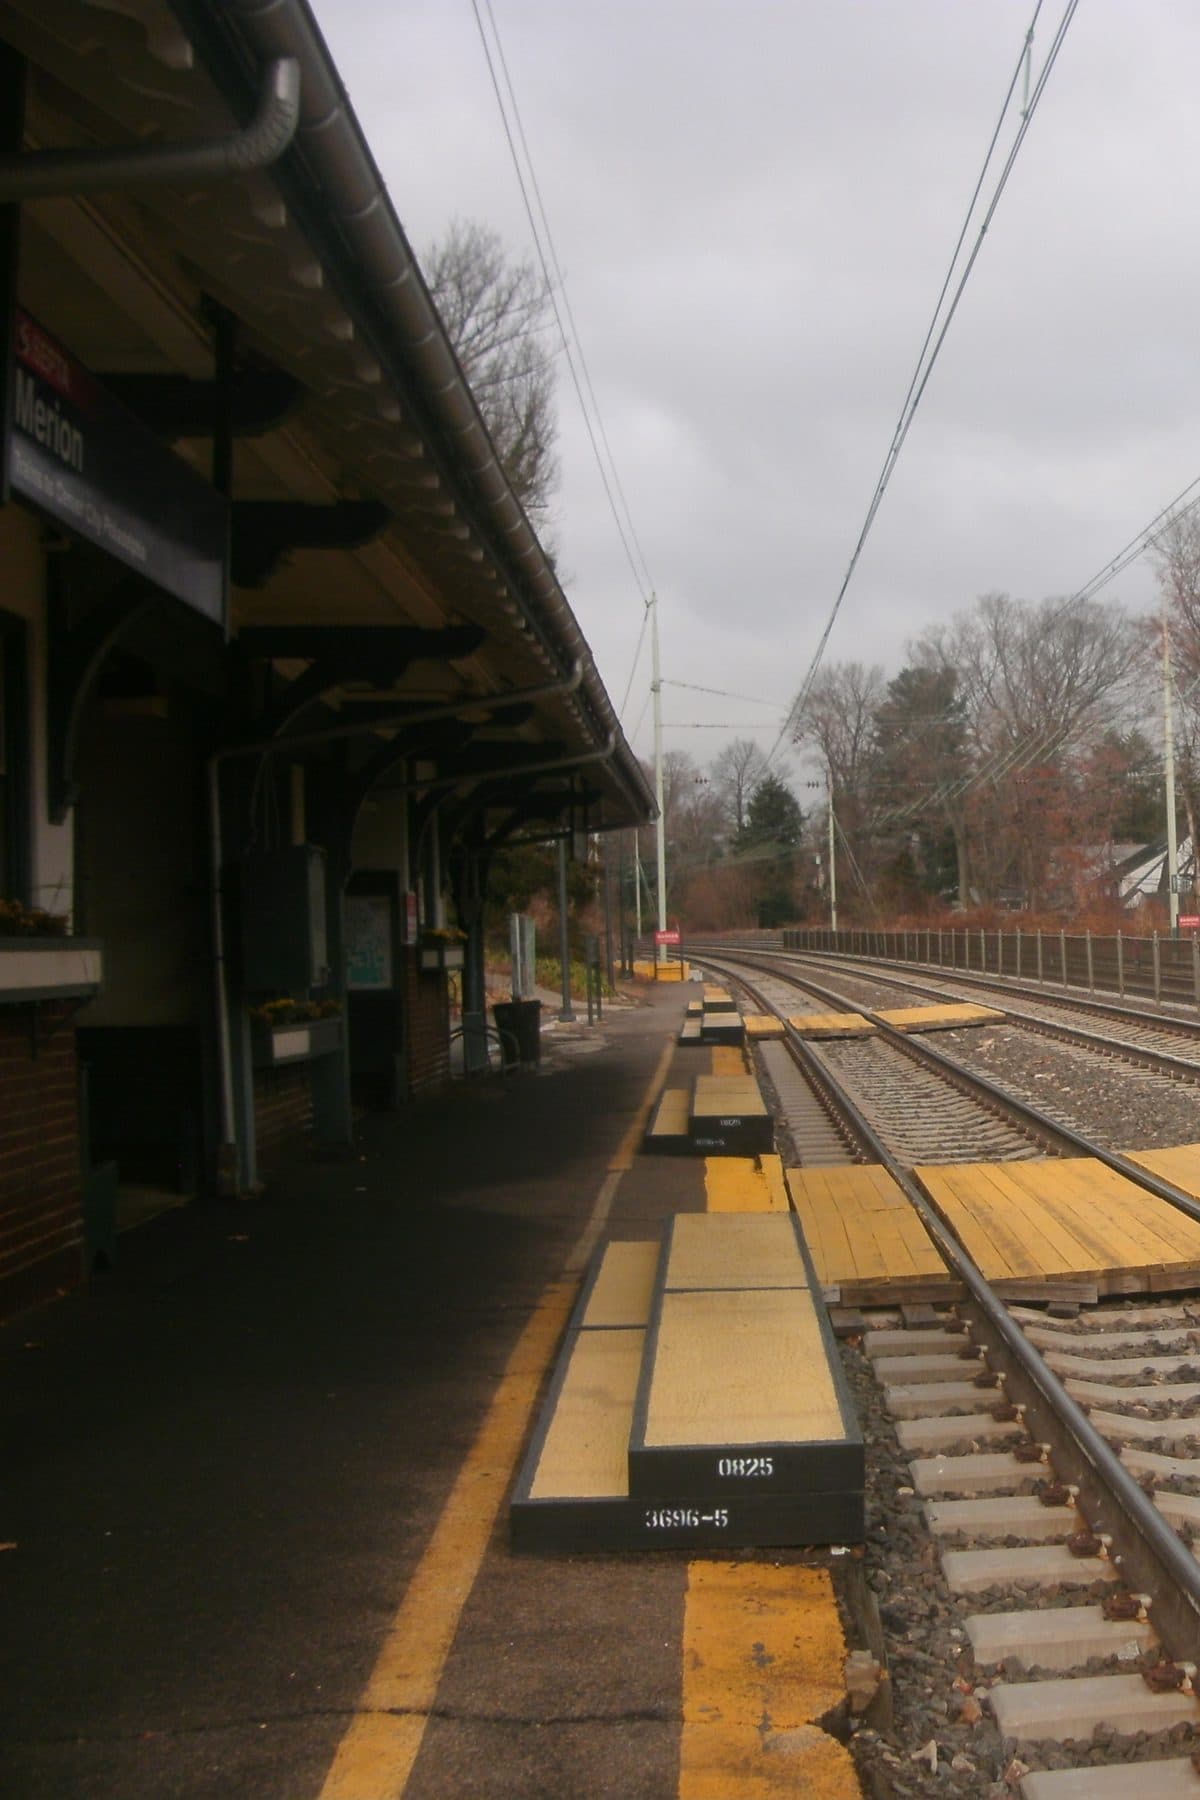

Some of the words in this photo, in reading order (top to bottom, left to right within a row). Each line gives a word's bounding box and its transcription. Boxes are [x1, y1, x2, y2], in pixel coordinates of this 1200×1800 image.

[14, 366, 83, 473] Merion
[718, 1458, 774, 1477] 0825
[645, 1509, 729, 1528] 3696-5
